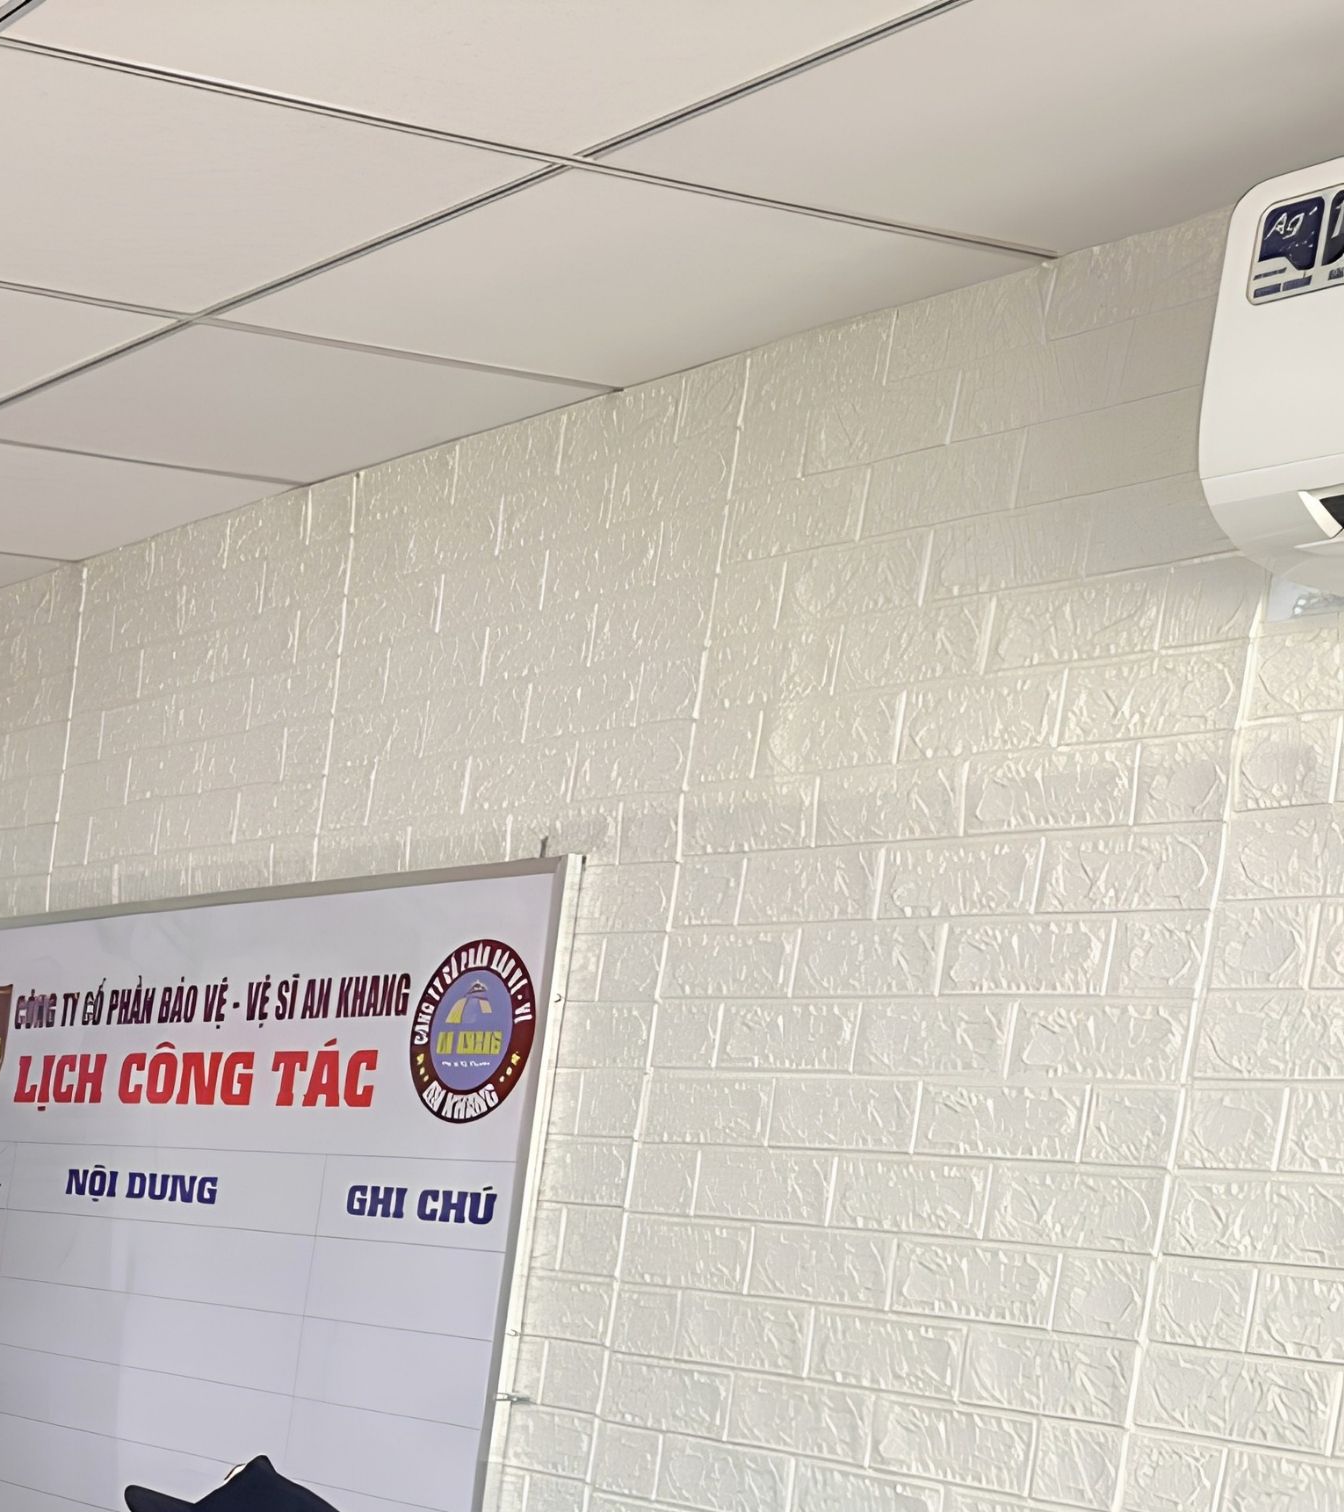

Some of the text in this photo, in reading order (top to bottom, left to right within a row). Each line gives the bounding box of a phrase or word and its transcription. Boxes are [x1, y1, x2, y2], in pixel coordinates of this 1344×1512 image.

[61, 992, 80, 1027] TY
[301, 978, 332, 1020] AN
[335, 973, 411, 1019] KHANG
[14, 1038, 378, 1111] LỊCH CÔNG TÁC
[65, 1165, 218, 1205] NỘI DUNG
[346, 1184, 498, 1225] GHI CHÚ
